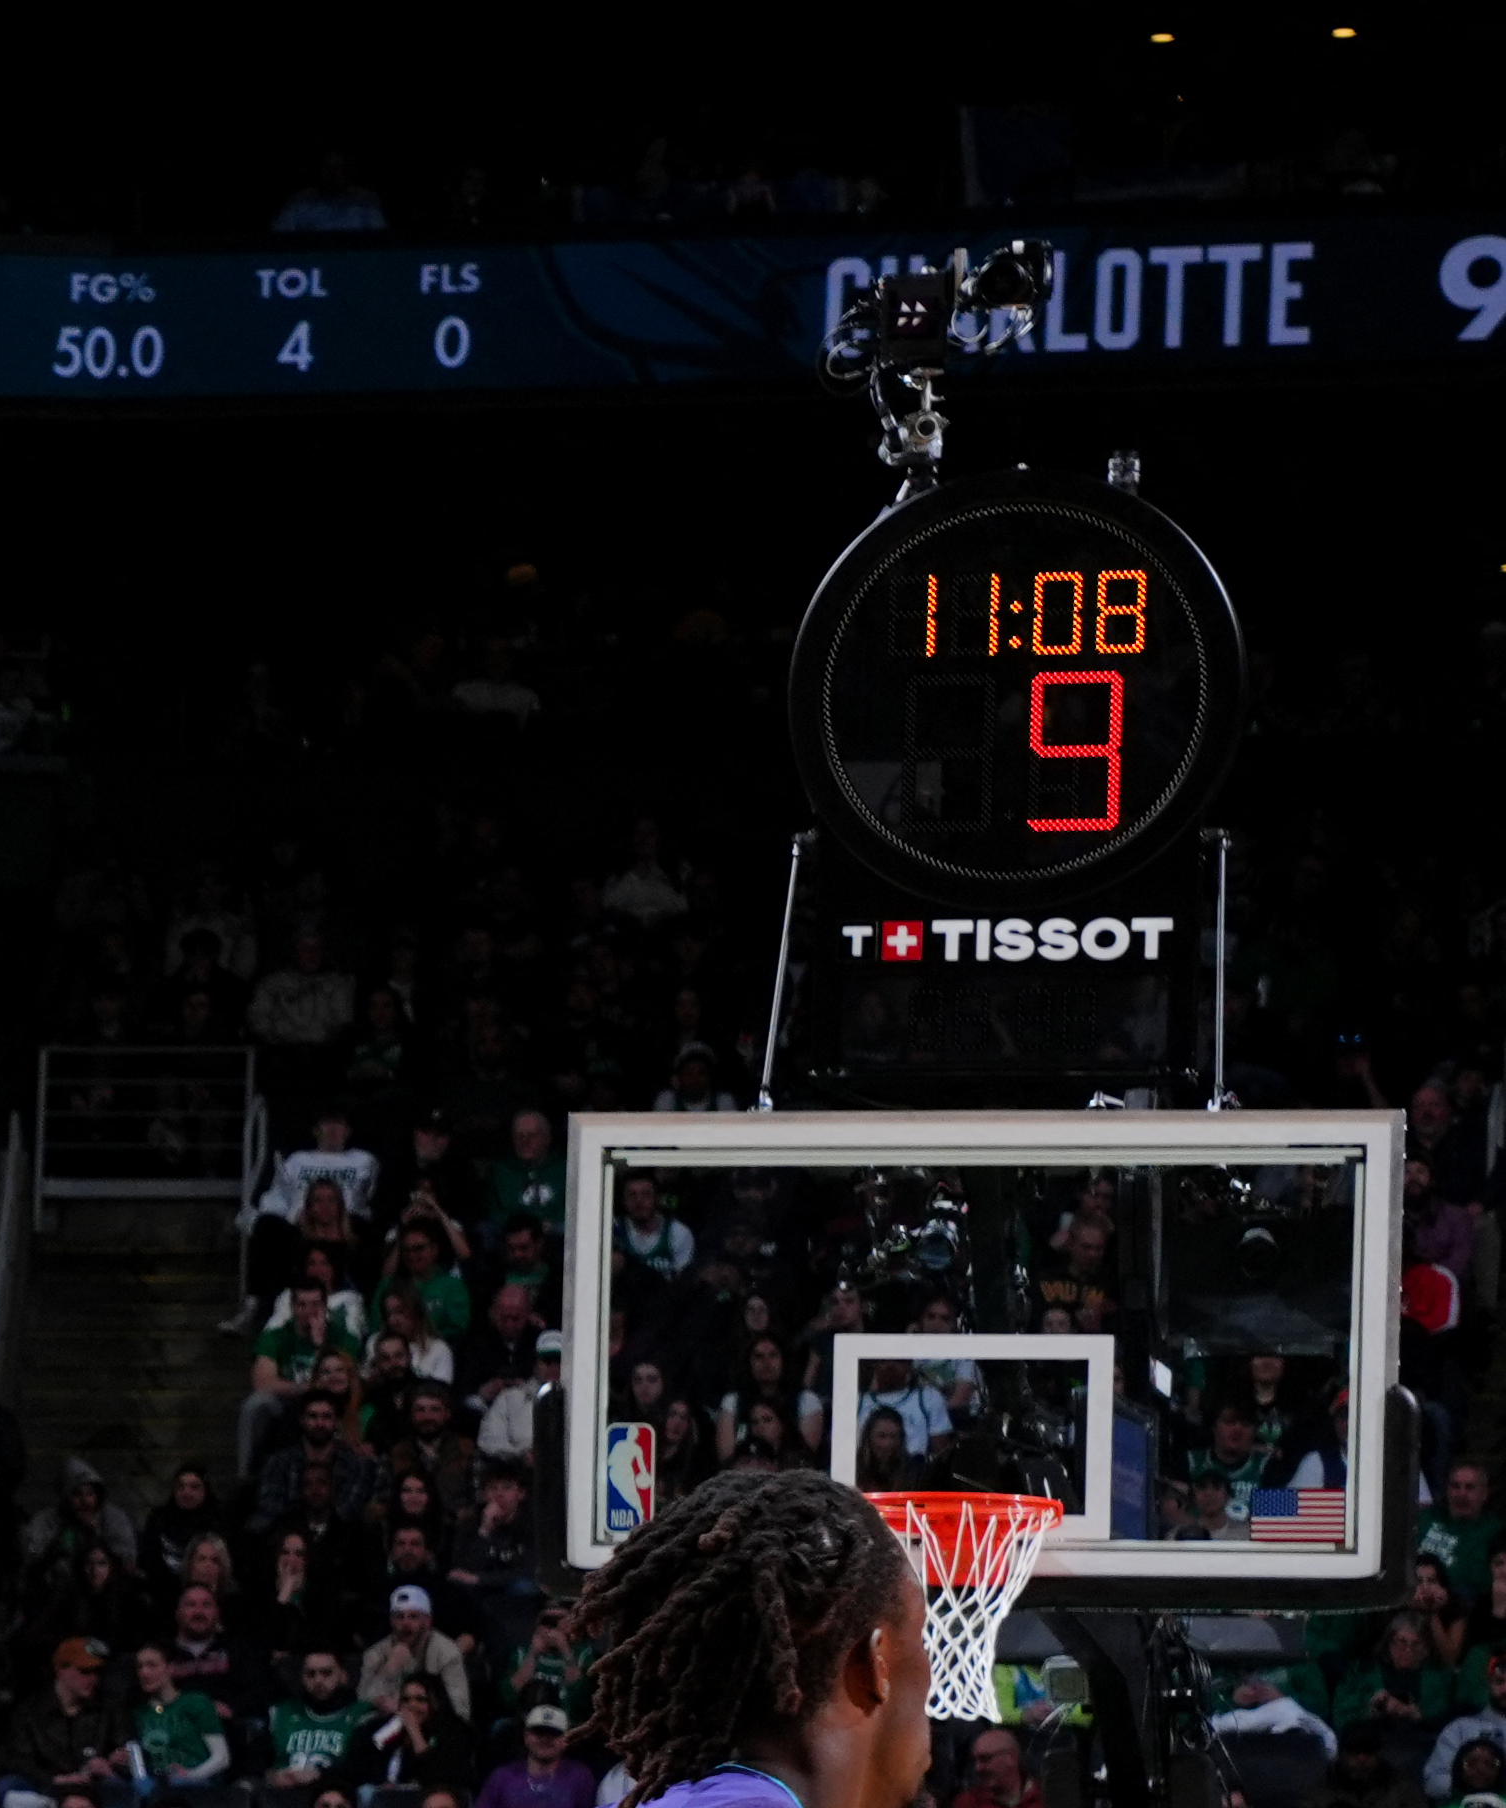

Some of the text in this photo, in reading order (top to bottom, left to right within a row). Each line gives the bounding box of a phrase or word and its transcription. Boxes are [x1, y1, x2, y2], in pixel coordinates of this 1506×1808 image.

[70, 272, 157, 305] FG%
[256, 268, 329, 299] TOL
[420, 263, 481, 296] FLS
[52, 324, 165, 380] 50.0
[276, 320, 315, 373] 4
[434, 315, 472, 369] 0
[925, 569, 1147, 658] 11:08
[1027, 670, 1124, 832] 9
[931, 916, 1174, 962] TISSOT
[611, 1507, 635, 1529] NBA
